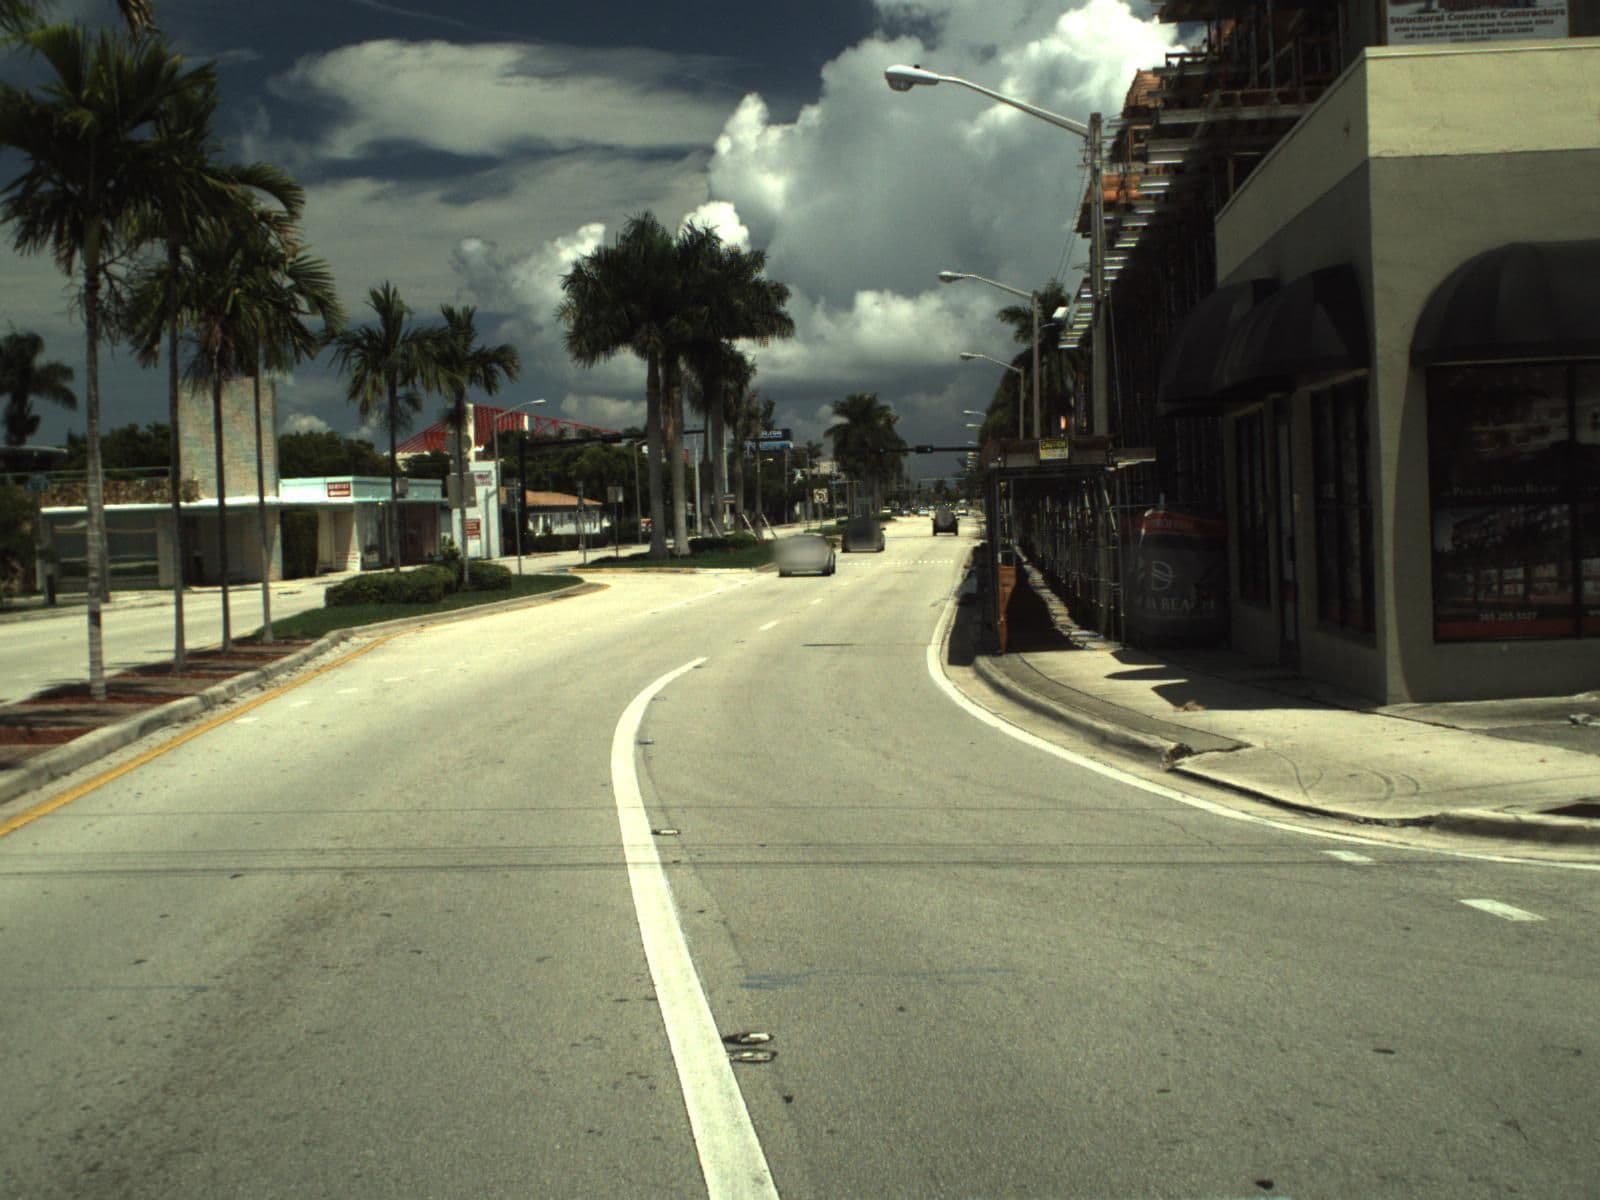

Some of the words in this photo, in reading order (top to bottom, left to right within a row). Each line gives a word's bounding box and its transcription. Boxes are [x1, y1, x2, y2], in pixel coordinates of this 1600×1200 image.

[1390, 14, 1444, 24] Structural
[1448, 12, 1497, 21] Concrete
[1501, 8, 1565, 17] Contractors
